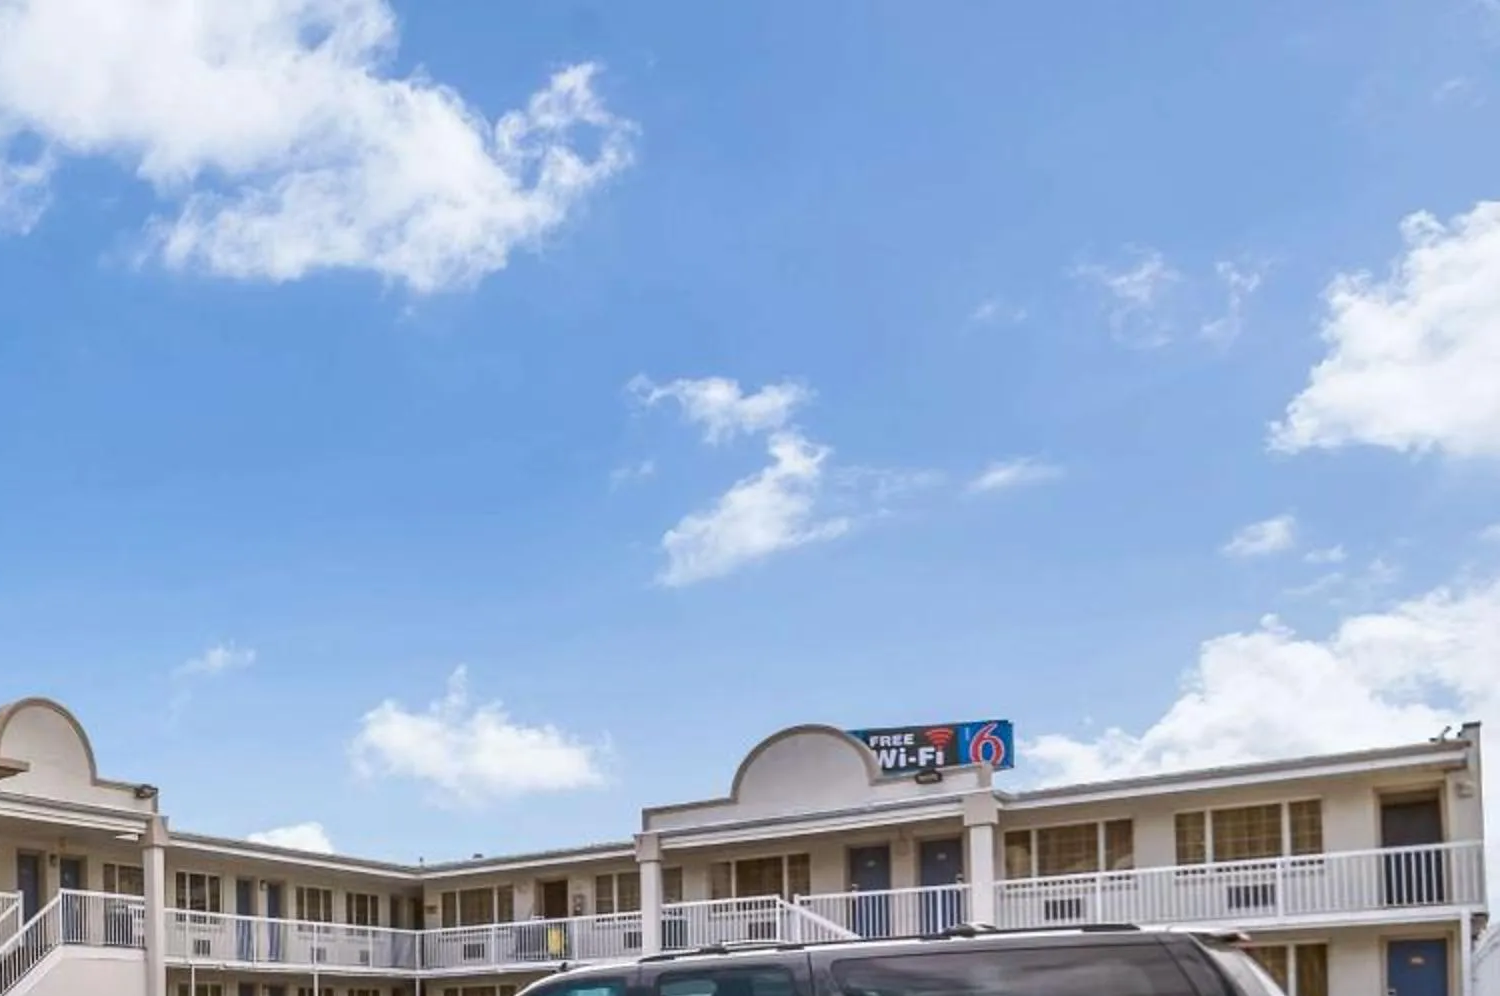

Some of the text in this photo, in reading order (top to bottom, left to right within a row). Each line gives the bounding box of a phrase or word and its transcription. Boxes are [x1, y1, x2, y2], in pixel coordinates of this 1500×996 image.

[869, 733, 915, 748] FREE
[969, 722, 1005, 765] 6
[876, 747, 945, 769] Wi-Fi
